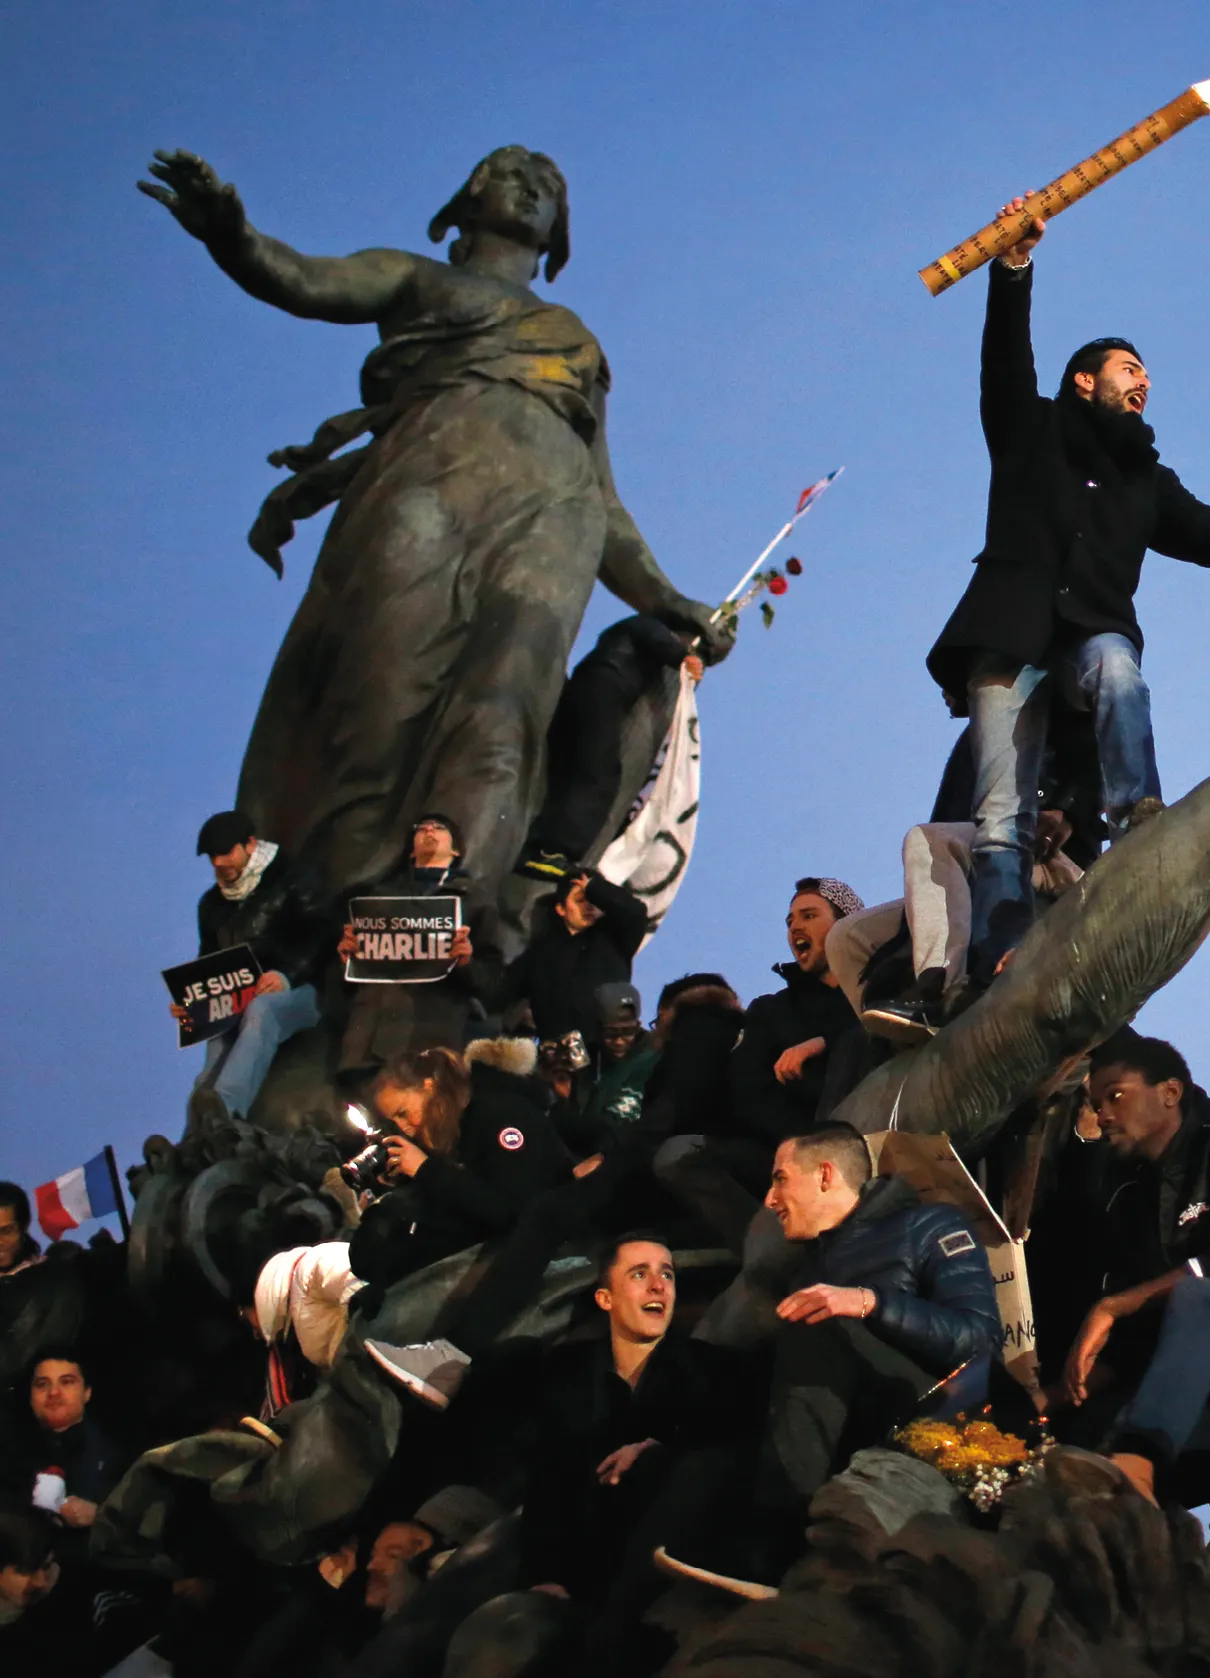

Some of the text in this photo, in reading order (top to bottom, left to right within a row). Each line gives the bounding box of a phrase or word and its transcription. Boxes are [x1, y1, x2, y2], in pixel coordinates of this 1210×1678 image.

[354, 916, 453, 930] NOUS SOMMES
[356, 932, 452, 960] CHARLIE
[182, 967, 254, 1003] JE SUIS
